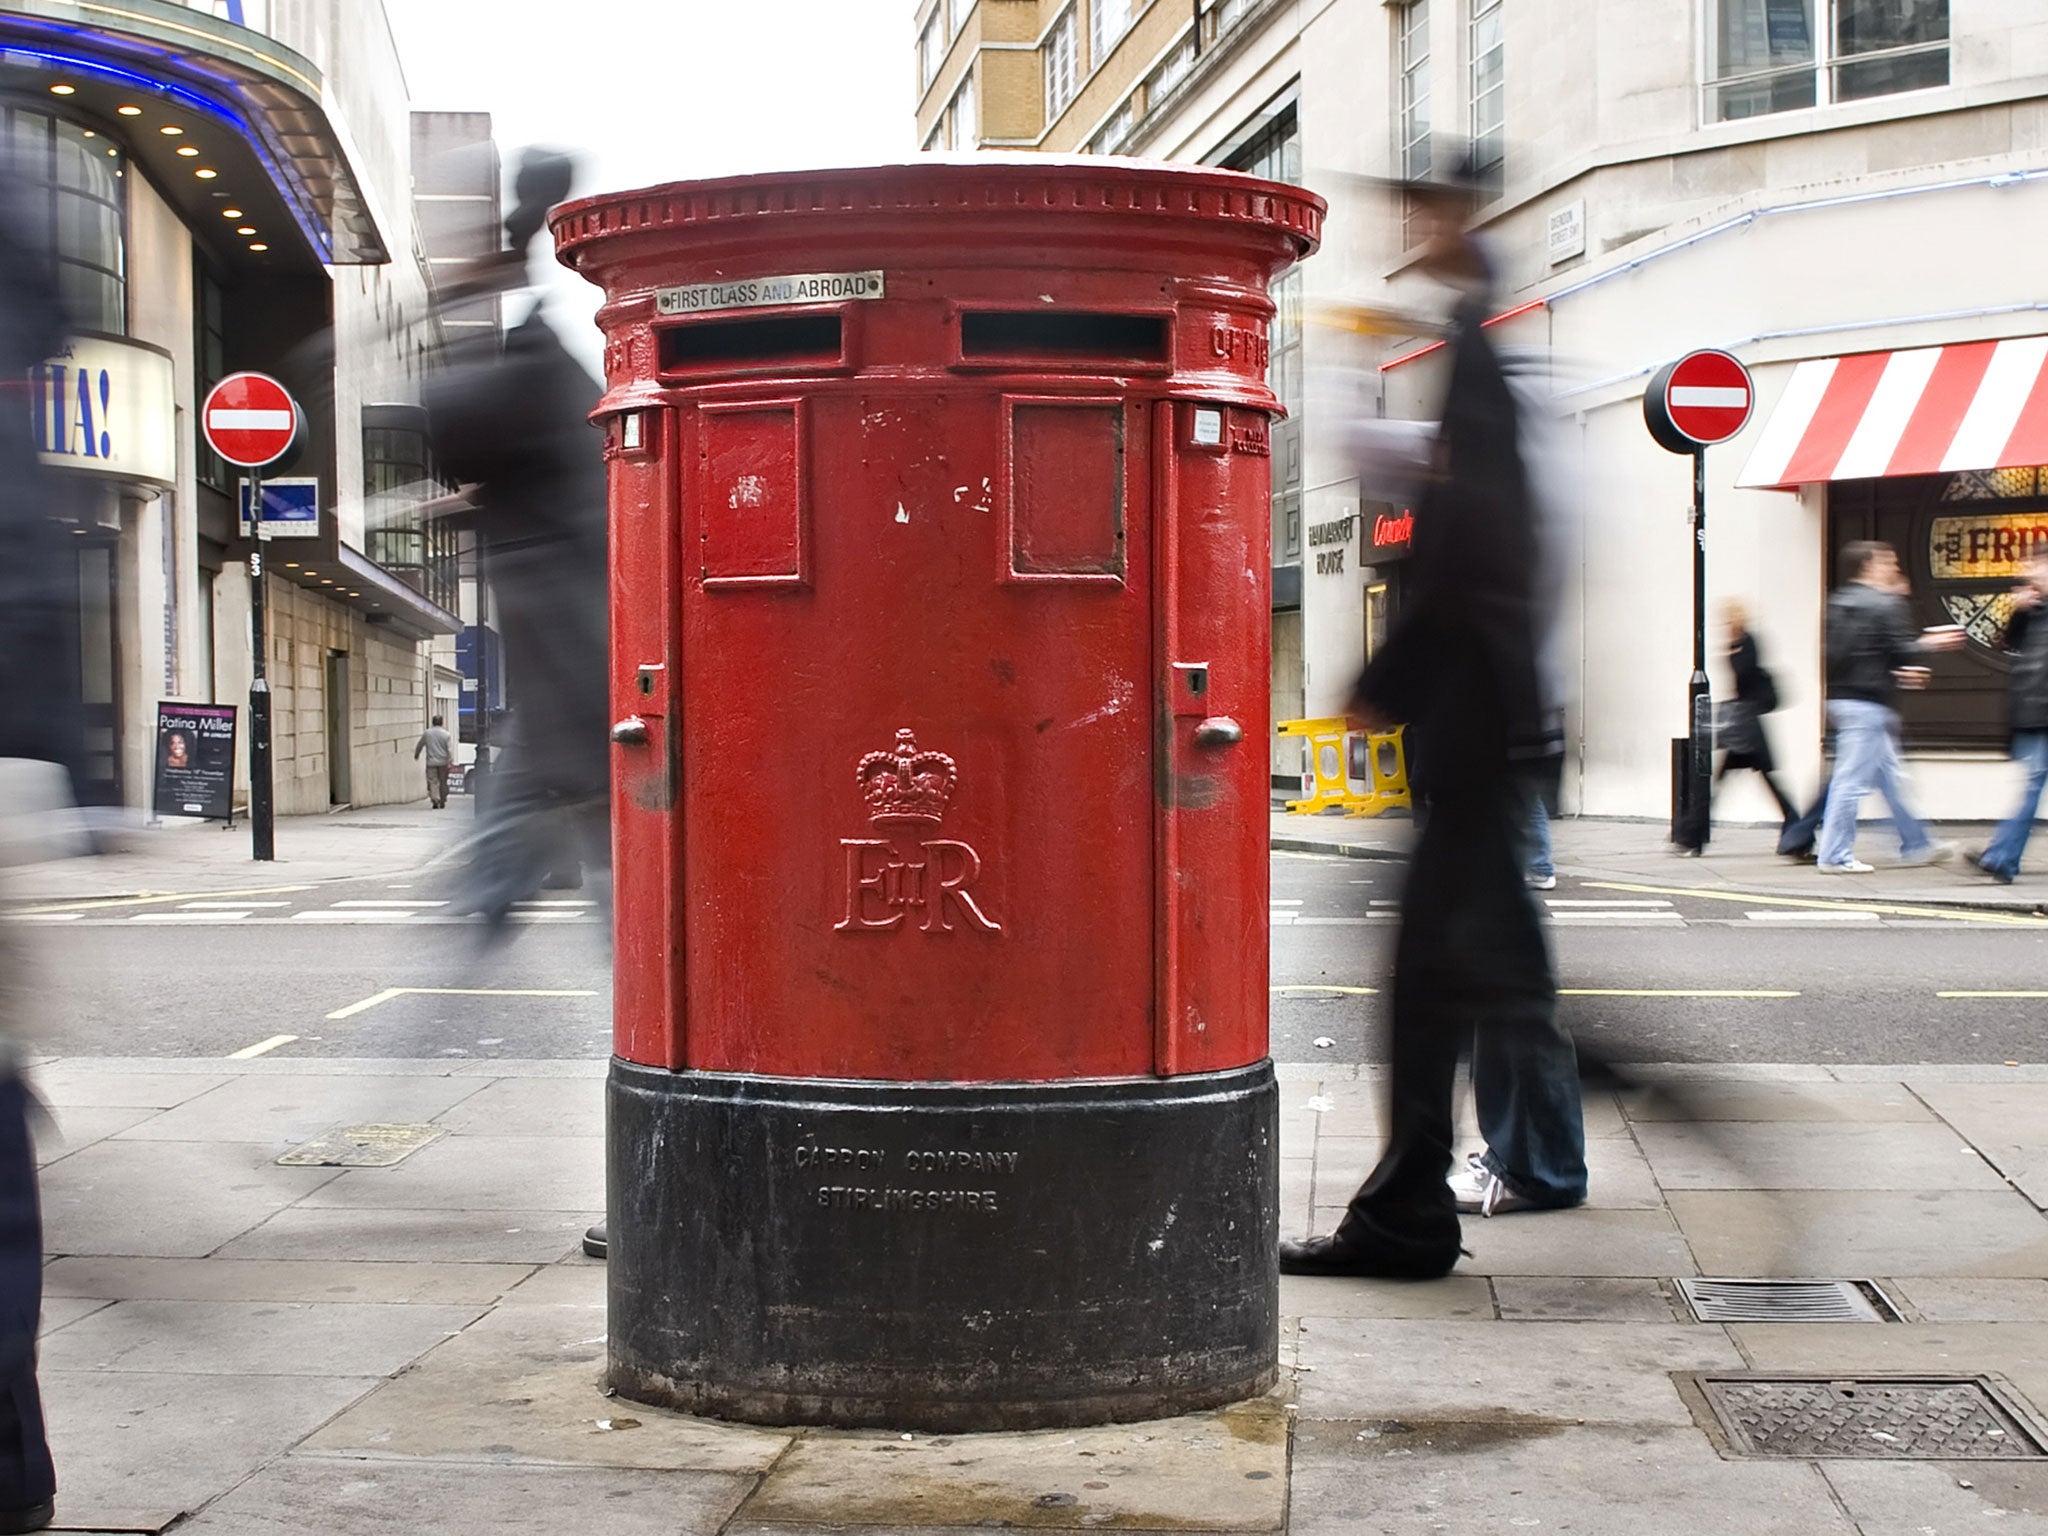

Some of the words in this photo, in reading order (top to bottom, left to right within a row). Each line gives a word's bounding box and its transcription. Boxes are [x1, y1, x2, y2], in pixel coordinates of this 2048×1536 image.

[670, 289, 708, 310] FIRST
[710, 284, 758, 305] CLASS
[762, 281, 793, 301] AND
[797, 276, 867, 299] ABROAD
[1316, 548, 1345, 575] HOUSE
[160, 714, 196, 730] Patina
[199, 717, 234, 732] Miller
[906, 1149, 1019, 1174] COMPANY
[817, 1186, 999, 1212] STIRLINGSHIRE
